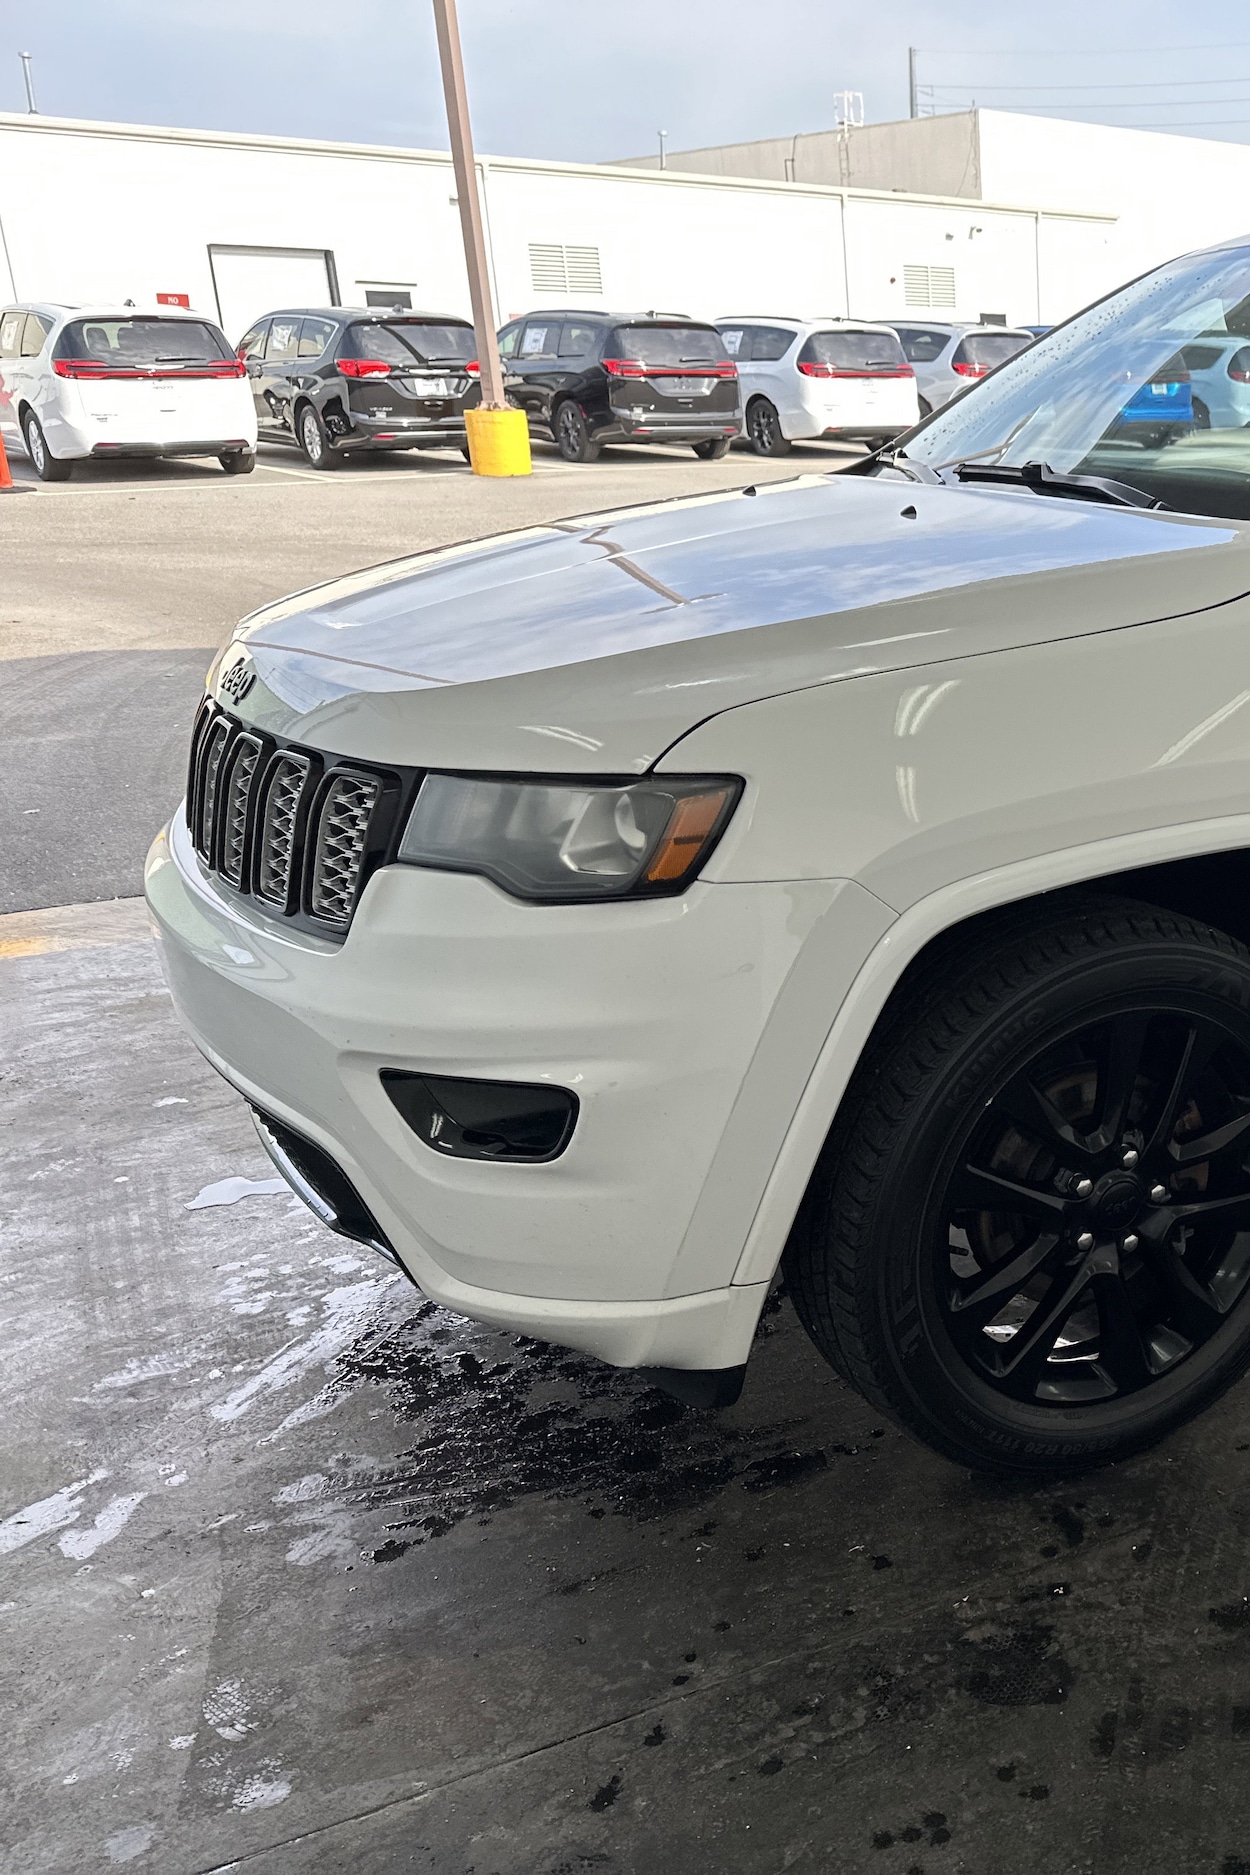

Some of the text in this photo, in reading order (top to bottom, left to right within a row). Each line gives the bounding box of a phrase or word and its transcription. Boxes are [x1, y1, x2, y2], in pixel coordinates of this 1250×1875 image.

[167, 296, 179, 305] NO
[220, 657, 257, 706] Jeep
[944, 1006, 1047, 1112] KUMHO
